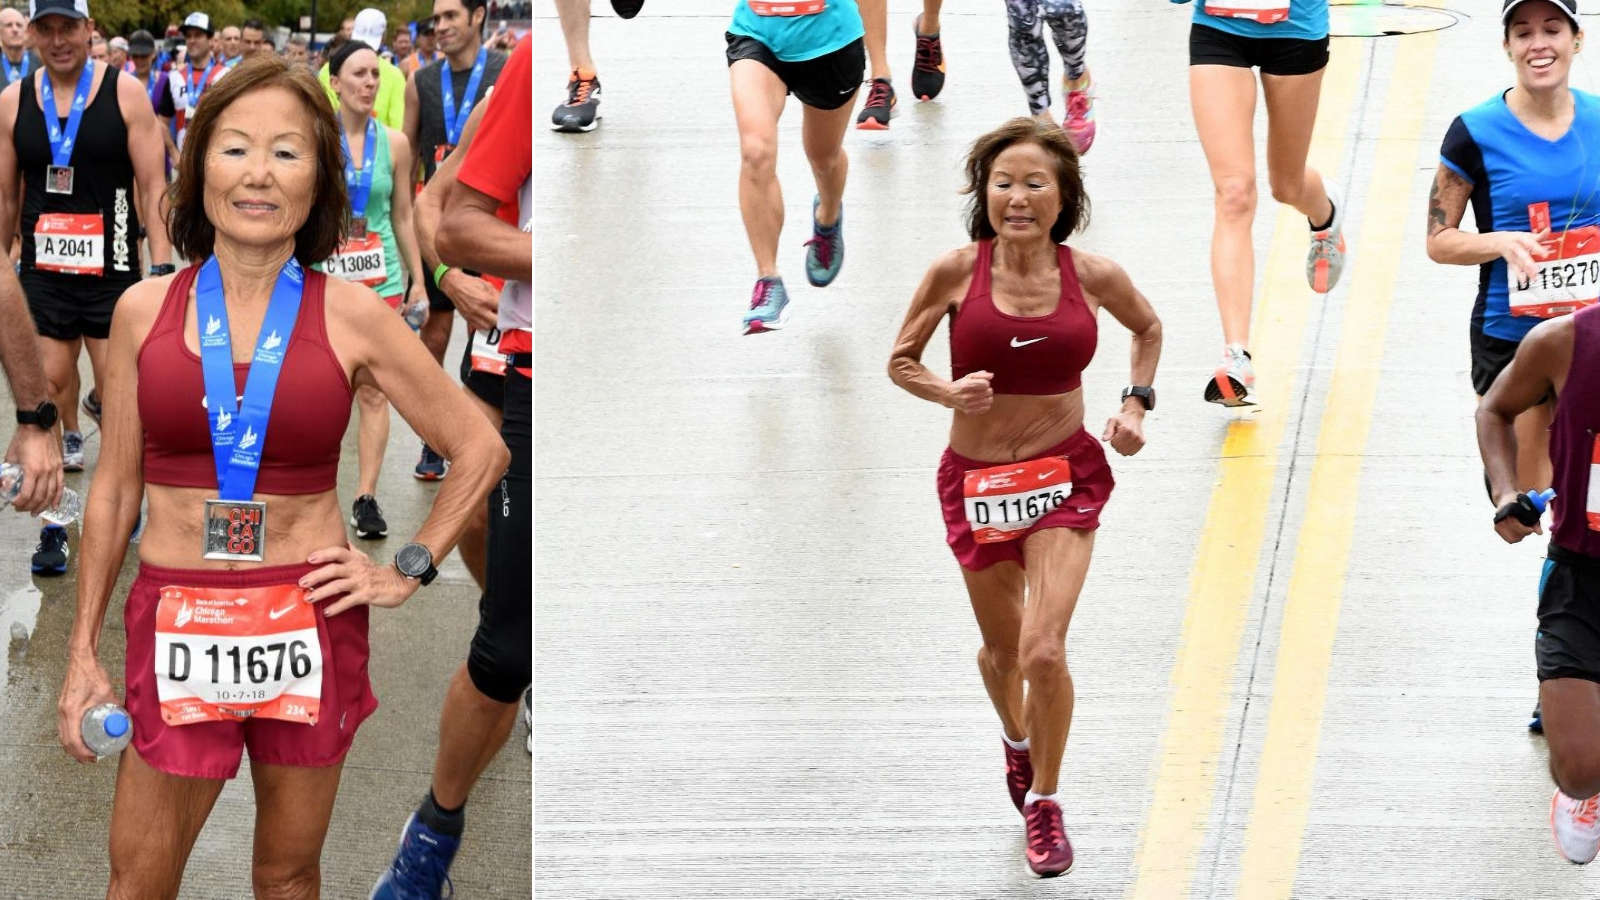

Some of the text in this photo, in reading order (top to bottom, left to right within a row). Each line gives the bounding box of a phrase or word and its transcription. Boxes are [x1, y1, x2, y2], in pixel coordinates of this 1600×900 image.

[44, 237, 93, 257] A 2041
[113, 212, 130, 272] HOKA
[327, 252, 381, 273] C 13083
[1538, 259, 1600, 290] 15270
[486, 326, 500, 345] D
[229, 507, 261, 525] CHI
[974, 489, 1064, 525] D 11676
[228, 523, 254, 540] CA
[227, 539, 255, 554] GO
[168, 640, 312, 684] D 11676
